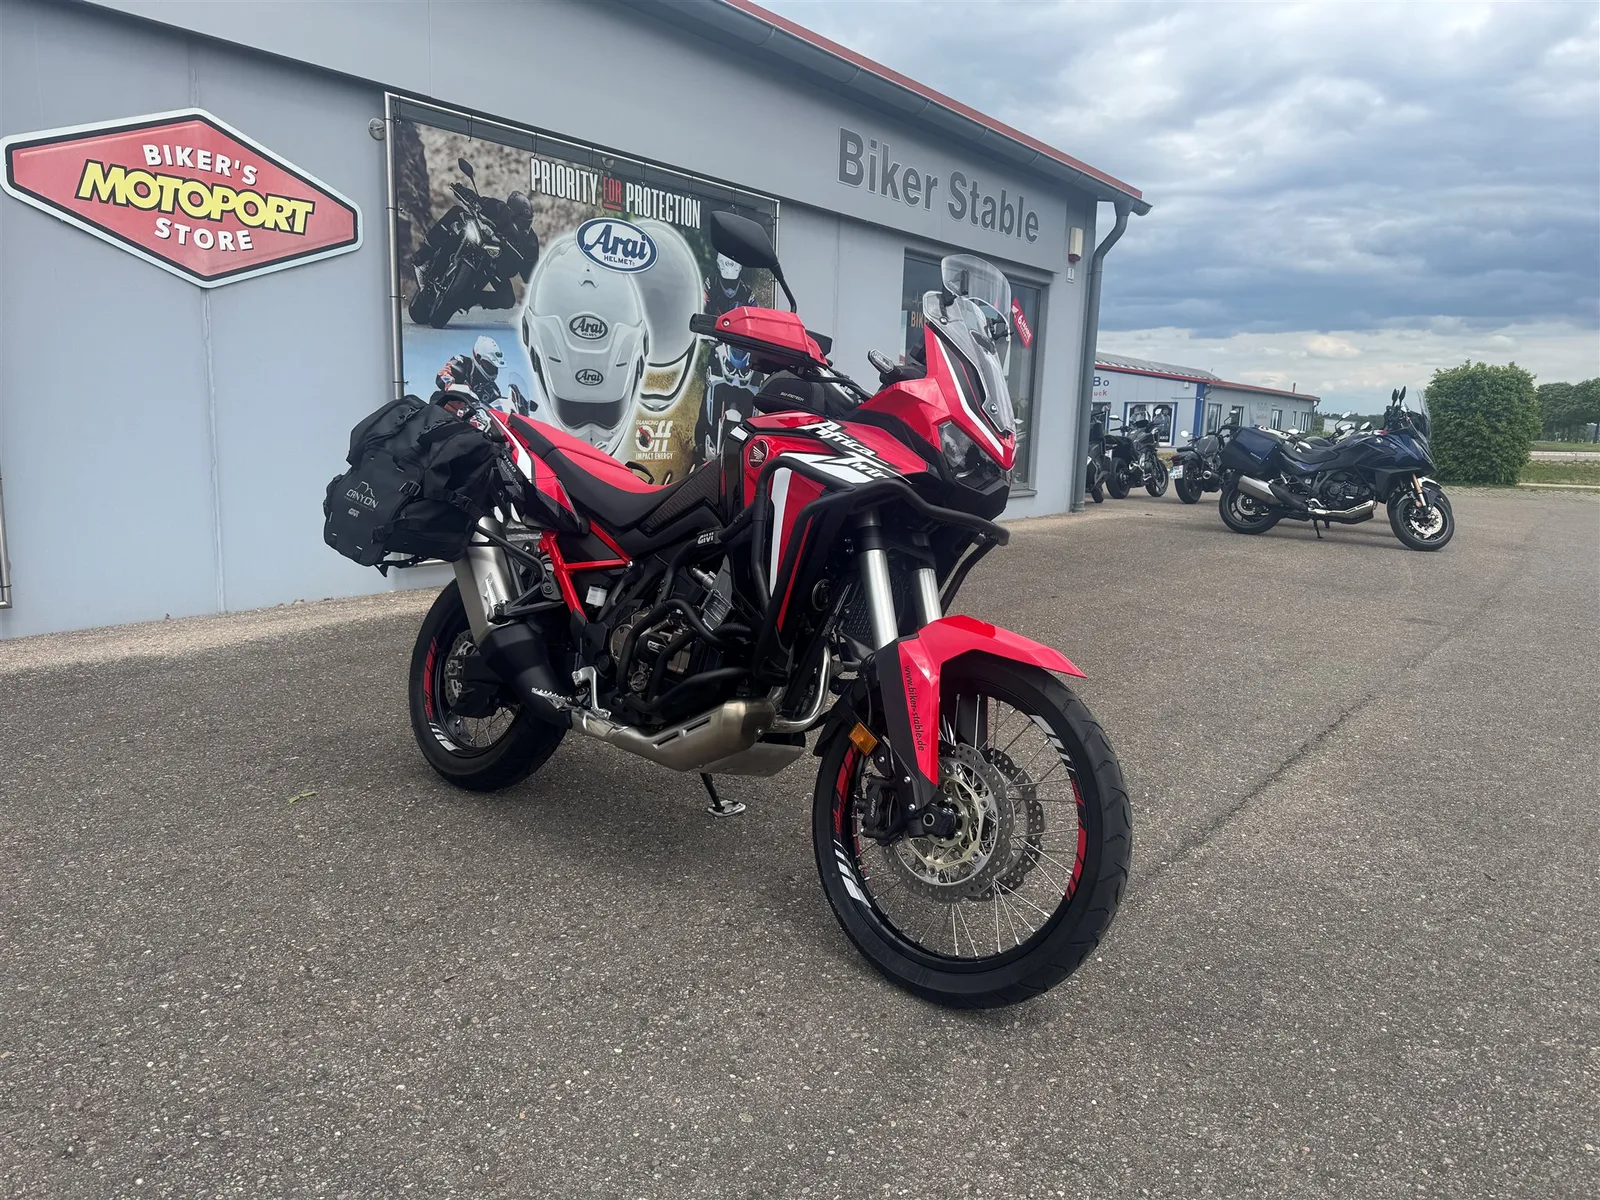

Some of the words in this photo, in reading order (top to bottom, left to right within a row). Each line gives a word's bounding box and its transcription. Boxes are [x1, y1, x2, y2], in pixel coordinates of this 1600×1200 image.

[142, 144, 258, 186] BIKER'S
[75, 159, 315, 235] MOTOPORT
[530, 157, 598, 205] PRIORITY
[603, 176, 622, 204] FOR
[626, 182, 700, 229] PROTECTION
[837, 126, 938, 211] Biker
[947, 169, 1039, 243] Stable
[154, 218, 254, 251] STORE
[583, 224, 648, 260] Arai
[604, 255, 633, 266] HELMET
[572, 318, 604, 335] Arai
[577, 370, 600, 381] Arai
[796, 419, 877, 456] Africa
[635, 452, 654, 460] IMPACT
[655, 452, 673, 460] ENERGY
[346, 488, 379, 508] CANYON
[697, 531, 714, 544] GIVI
[904, 665, 926, 751] www.biker-stable.de
